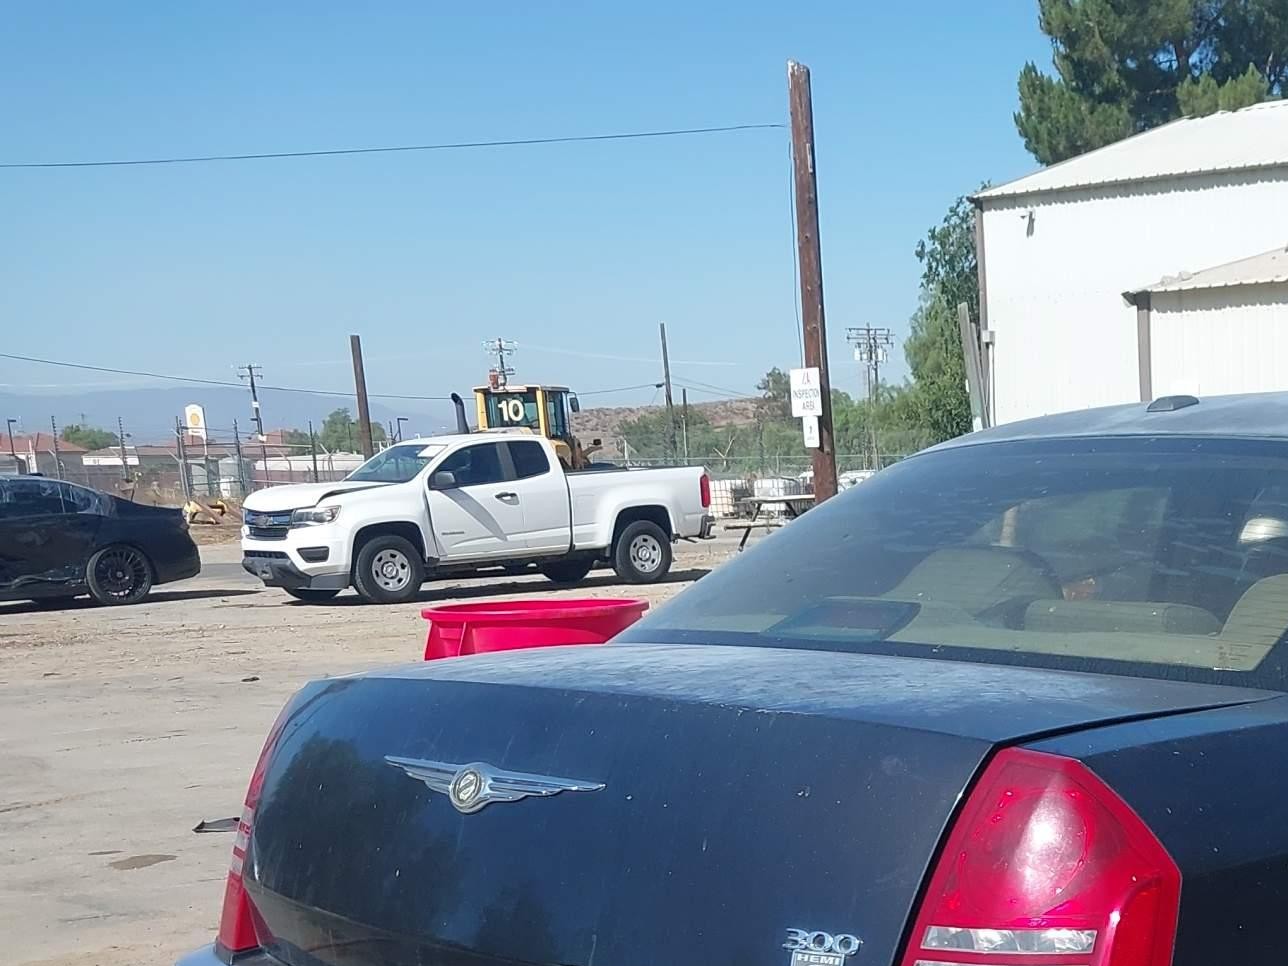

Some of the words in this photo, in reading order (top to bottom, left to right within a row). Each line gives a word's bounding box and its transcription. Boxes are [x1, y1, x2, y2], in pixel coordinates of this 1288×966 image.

[792, 387, 820, 399] INSPECTION
[498, 399, 525, 422] 10
[782, 928, 860, 955] 300
[796, 953, 841, 966] HEMI
